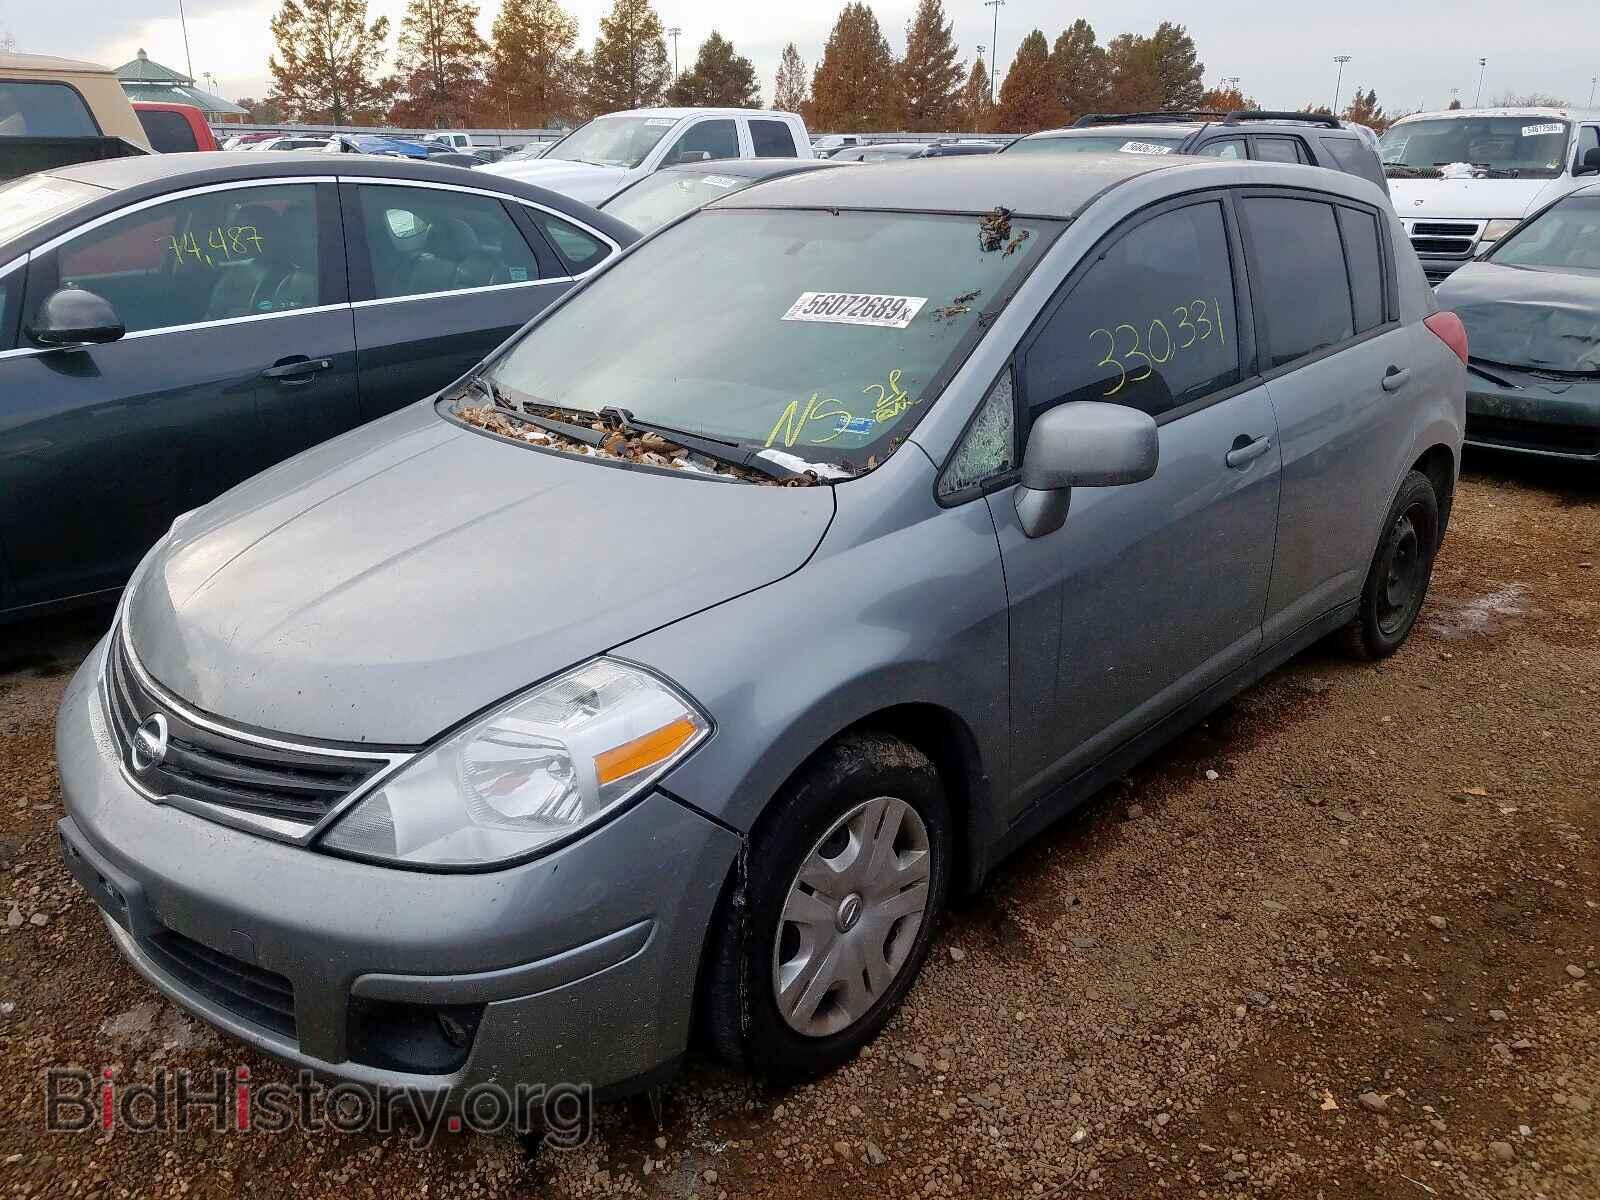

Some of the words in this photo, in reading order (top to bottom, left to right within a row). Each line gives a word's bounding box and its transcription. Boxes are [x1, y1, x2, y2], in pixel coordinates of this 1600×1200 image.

[153, 225, 264, 269] 74,487
[1089, 297, 1224, 396] 330,331
[765, 391, 852, 448] NS
